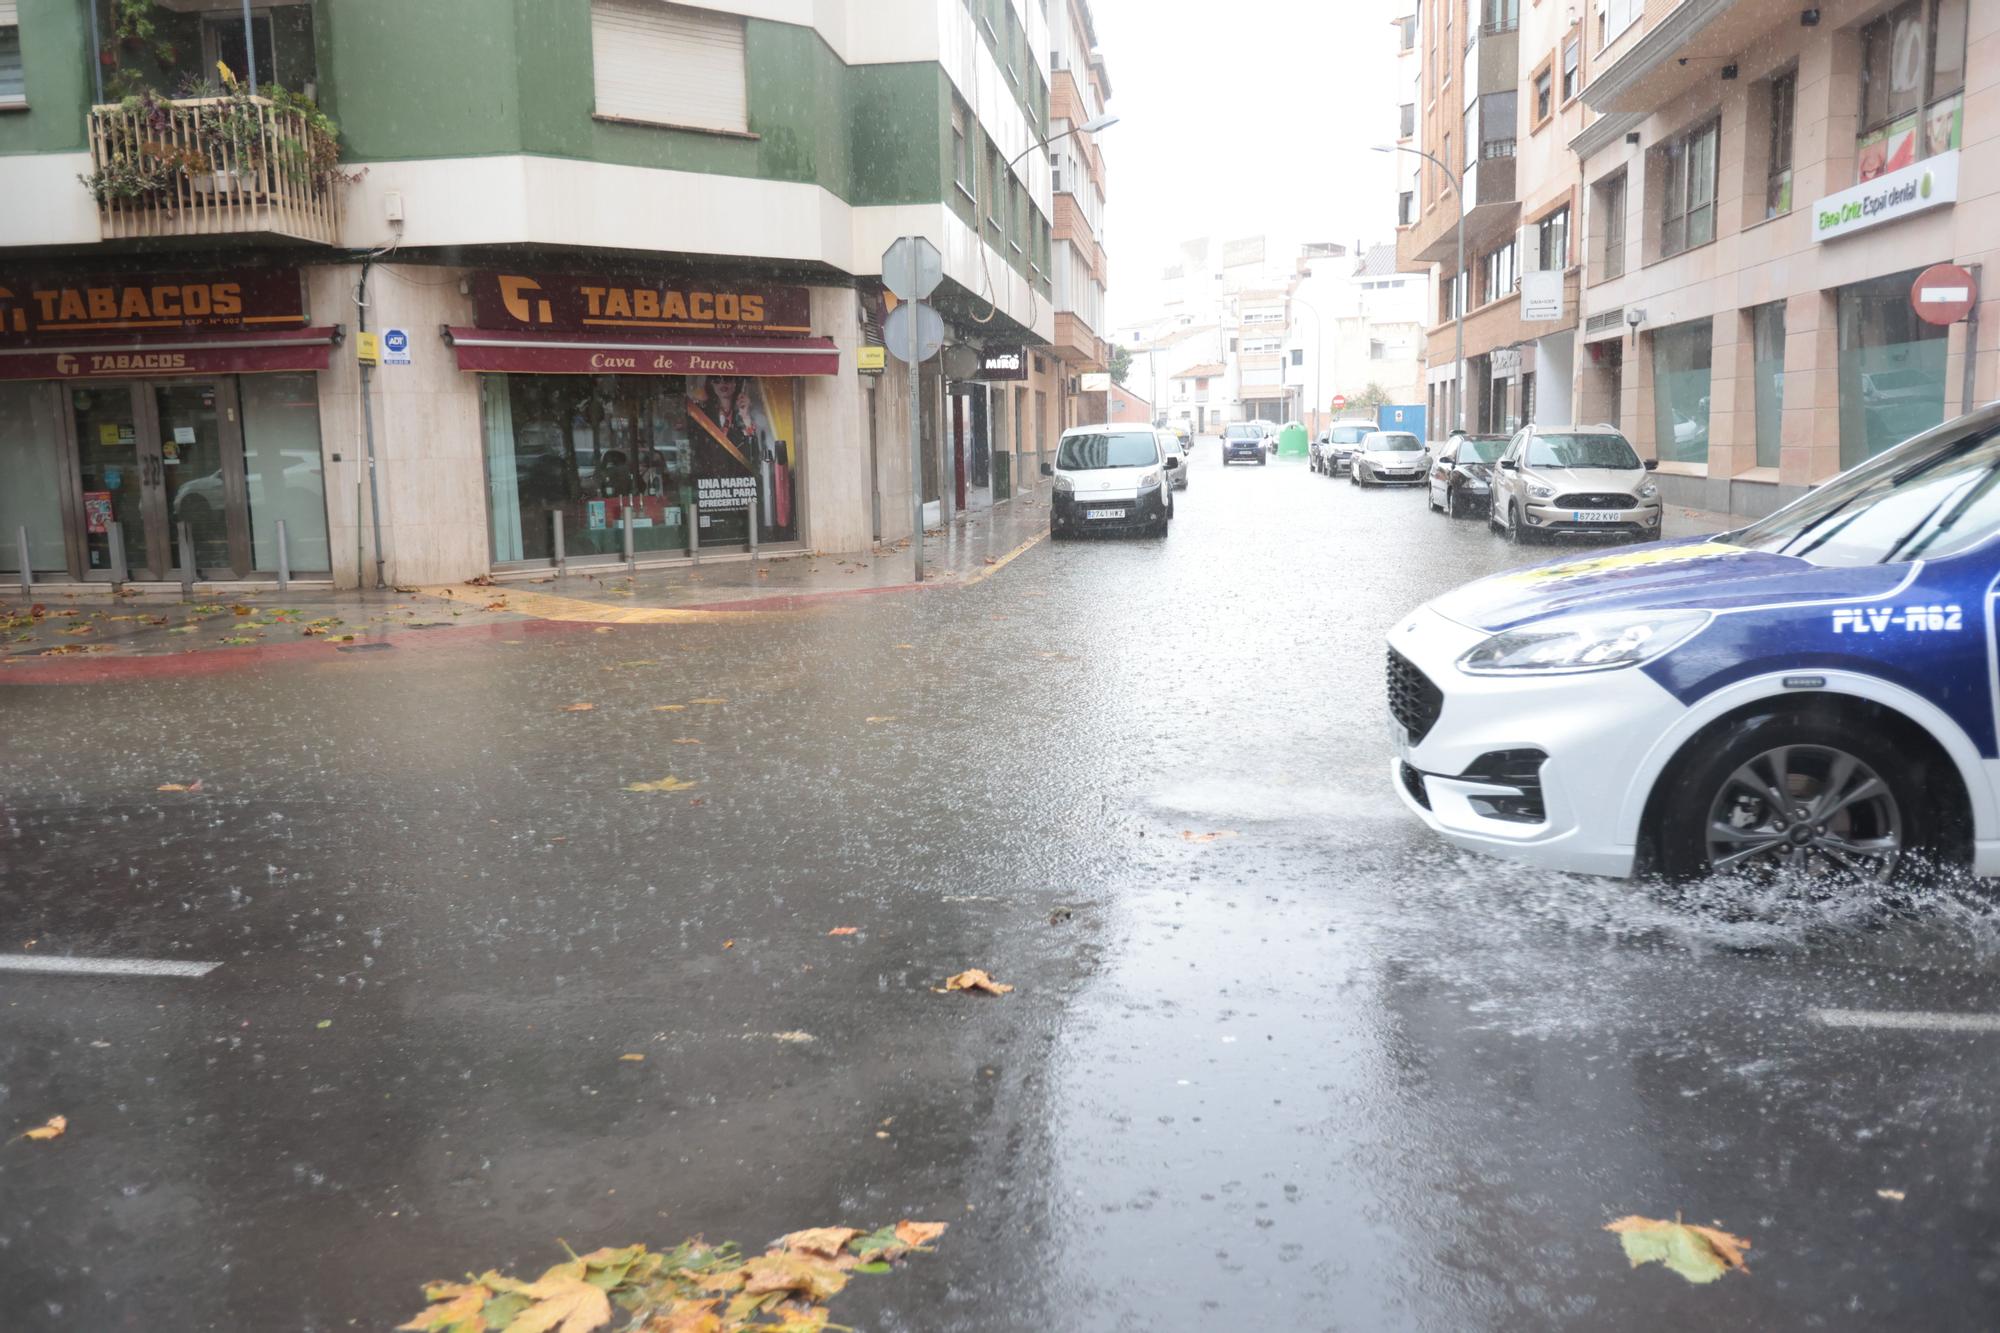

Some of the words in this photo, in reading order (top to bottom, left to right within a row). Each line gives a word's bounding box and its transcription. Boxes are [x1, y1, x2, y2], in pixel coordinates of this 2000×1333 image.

[1819, 211, 1839, 230] Elena
[1841, 201, 1862, 222] Ortiz
[1863, 190, 1887, 215] Espai
[1889, 179, 1917, 206] dental
[33, 284, 241, 320] TABACOS
[581, 287, 764, 322] TABACOS
[90, 354, 186, 370] TABACOS
[591, 353, 636, 368] Cava
[653, 355, 673, 369] de
[689, 355, 734, 370] Puros
[698, 479, 720, 489] UNA
[721, 477, 757, 488] MARCA
[698, 489, 732, 499] GLOBAL
[733, 487, 757, 497] PARA
[699, 498, 740, 507] OFRECERTE
[1580, 512, 1601, 520] 6722
